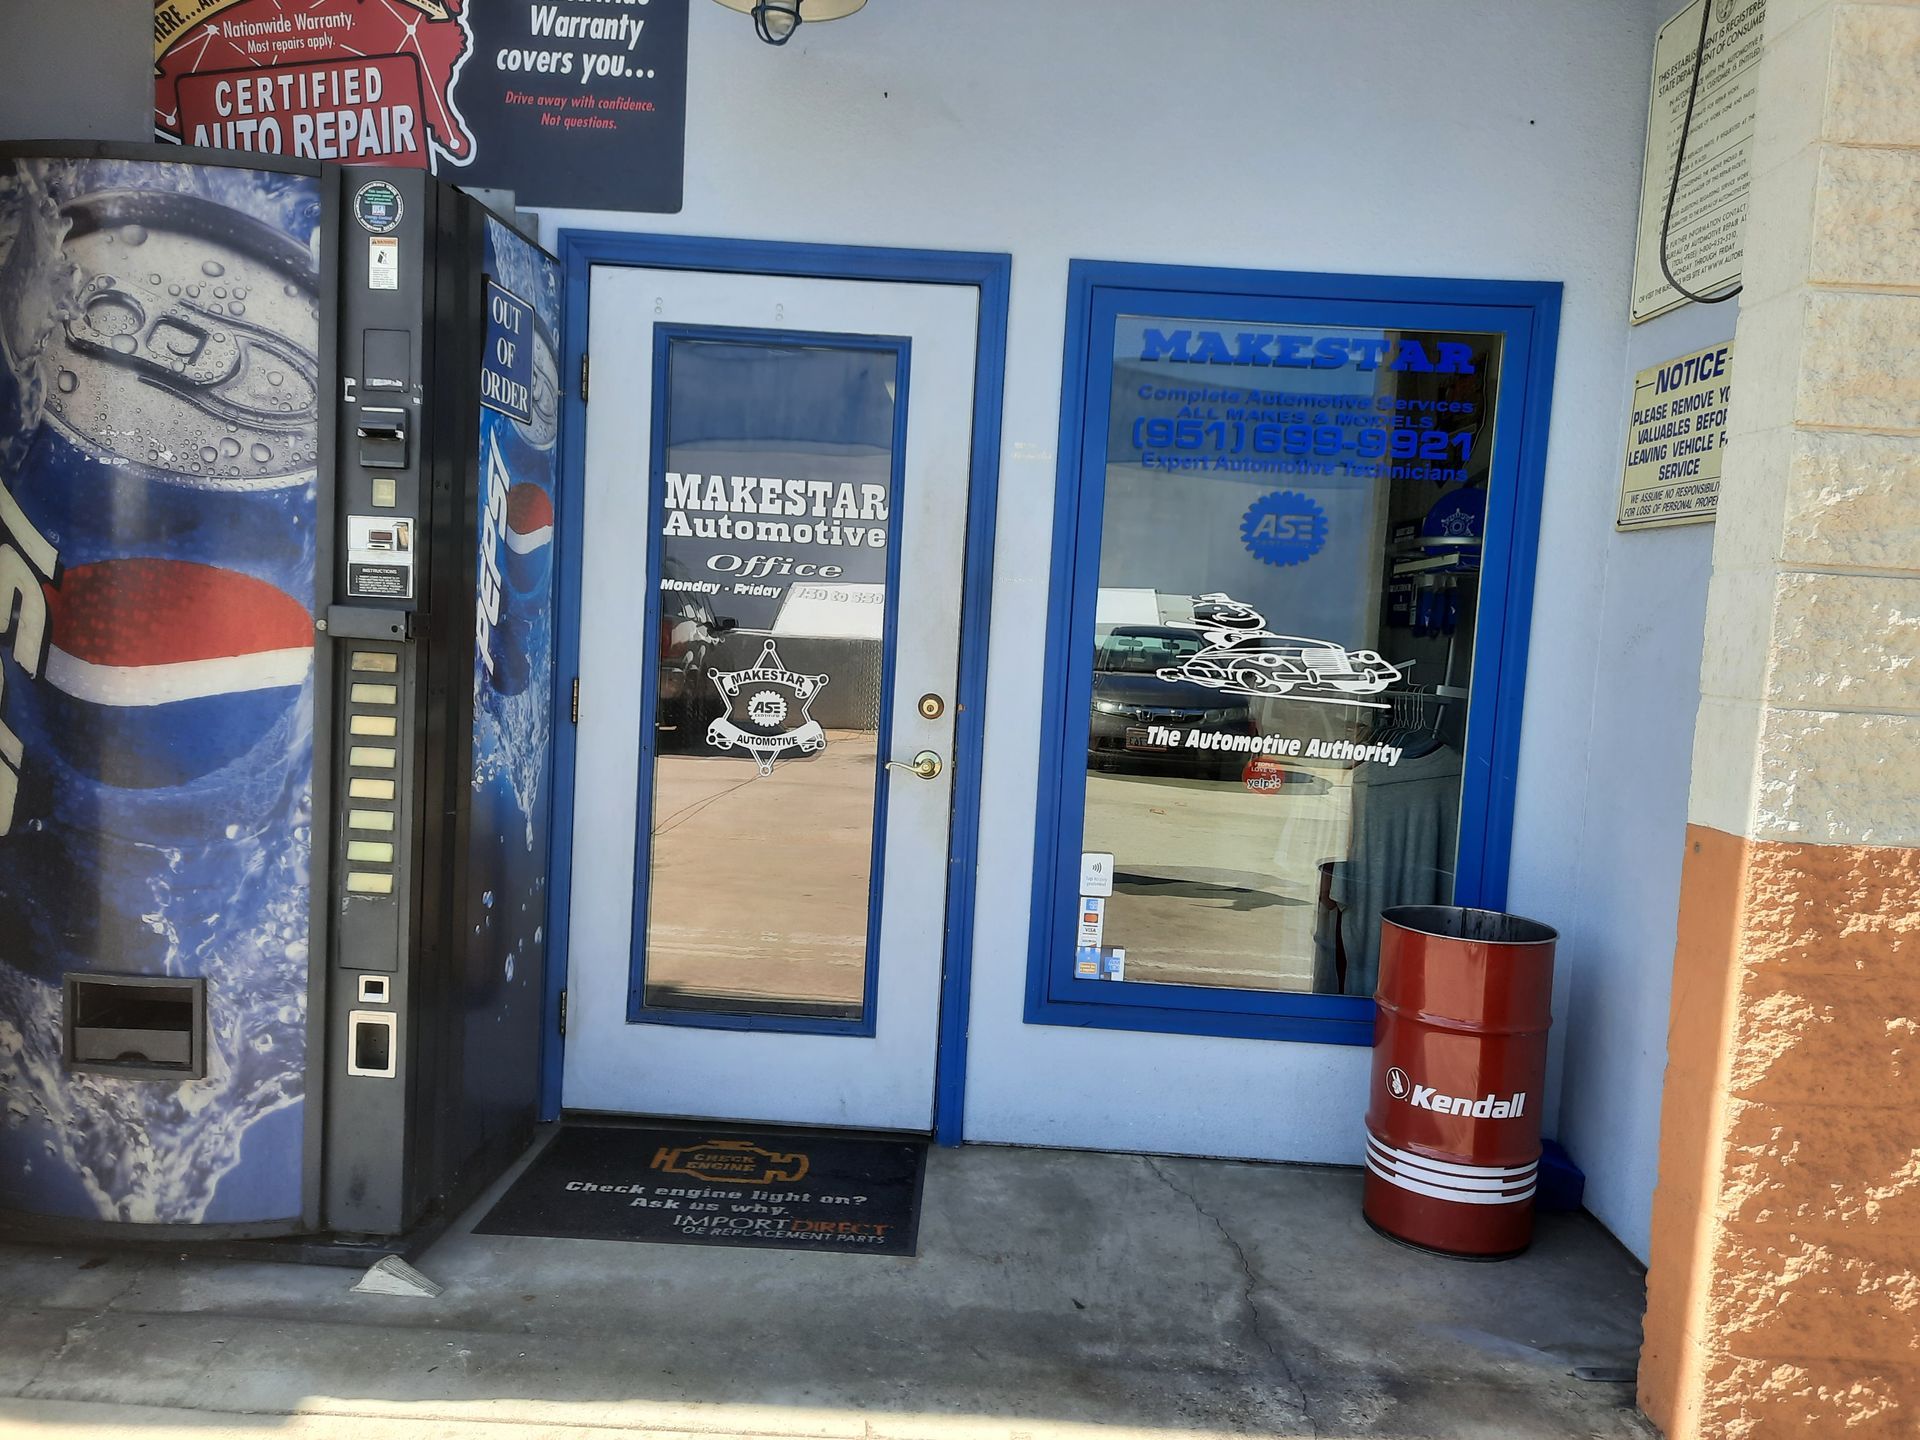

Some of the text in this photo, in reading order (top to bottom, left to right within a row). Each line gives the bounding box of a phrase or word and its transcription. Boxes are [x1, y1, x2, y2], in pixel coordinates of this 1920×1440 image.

[223, 11, 356, 38] Nationwide Warranty.
[530, 4, 644, 51] Warranty
[247, 32, 336, 54] Most repairs apply.
[496, 48, 655, 84] covers you...
[1657, 68, 1670, 85] THIS
[215, 67, 382, 117] CERTIFIED
[1658, 76, 1675, 97] STATE
[504, 91, 656, 111] Drive away with confidence.
[292, 105, 416, 160] REPAIR
[541, 113, 617, 130] Not questions.
[492, 295, 521, 335] OUT
[496, 337, 516, 369] OF
[1140, 328, 1476, 375] MAKESTAR
[1655, 348, 1728, 395] NOTICE
[481, 367, 528, 413] ORDER
[1138, 384, 1475, 414] Complete Automotive Services
[1176, 405, 1218, 420] ALL
[1226, 408, 1303, 425] MAKES
[1335, 414, 1435, 430] MODELS
[1633, 403, 1668, 427] PLEASE
[1671, 390, 1714, 418] REMOVE
[1637, 418, 1690, 445] VALUABLES
[1628, 445, 1667, 467] LEAVING
[1672, 434, 1714, 458] VEHICLE
[1141, 451, 1469, 482] Expert Automotive Technicians
[1658, 458, 1700, 481] SERVICE
[664, 472, 888, 521] MAKESTAR
[1624, 506, 1635, 517] FOR
[1636, 504, 1651, 516] LOSS
[1653, 502, 1661, 513] OF
[1662, 499, 1692, 513] PERSONAL
[1630, 494, 1640, 504] WE
[1640, 489, 1664, 502] ASSUME
[1665, 487, 1674, 499] NO
[662, 510, 888, 548] Automotive
[1252, 513, 1316, 540] ASE
[706, 554, 844, 579] Office
[660, 579, 721, 596] Monday
[733, 583, 783, 600] Friday
[730, 669, 806, 688] MAKESTAR
[752, 701, 781, 714] ASE
[736, 734, 798, 747] AUTOMOTIVE
[1146, 725, 1403, 768] The Automotive Authority
[1247, 778, 1271, 790] yelp
[1411, 1084, 1526, 1119] Kendall
[685, 1162, 757, 1172] ENGINE
[693, 1153, 756, 1164] CHECK
[565, 1181, 867, 1205] Check engine light on?
[630, 1198, 789, 1216] Ask us why.
[682, 1226, 885, 1244] OE REPLACEMENT PARTS
